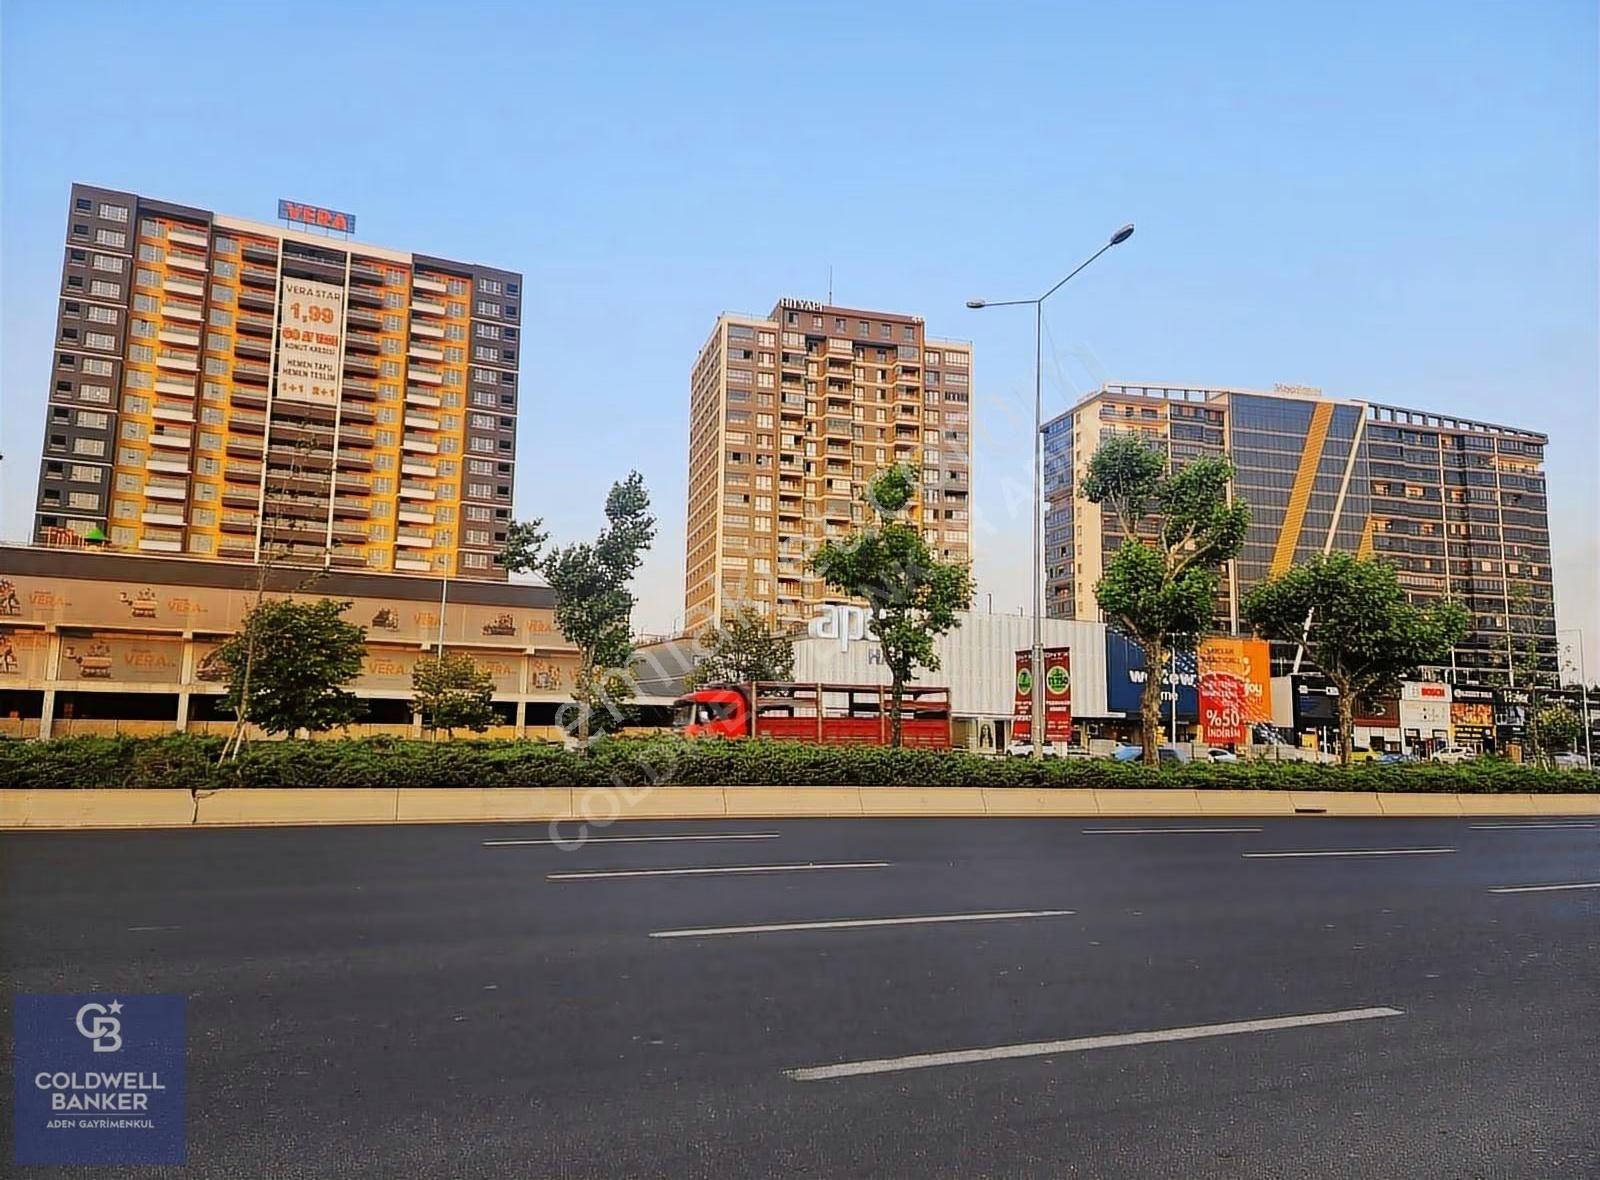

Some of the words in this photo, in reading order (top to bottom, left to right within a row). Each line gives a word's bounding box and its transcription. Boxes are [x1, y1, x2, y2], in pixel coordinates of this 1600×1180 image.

[287, 203, 348, 230] VERA
[124, 653, 168, 667] VERA
[368, 662, 405, 675] VERA
[1421, 687, 1446, 697] BOSCH
[1206, 709, 1240, 727] %50
